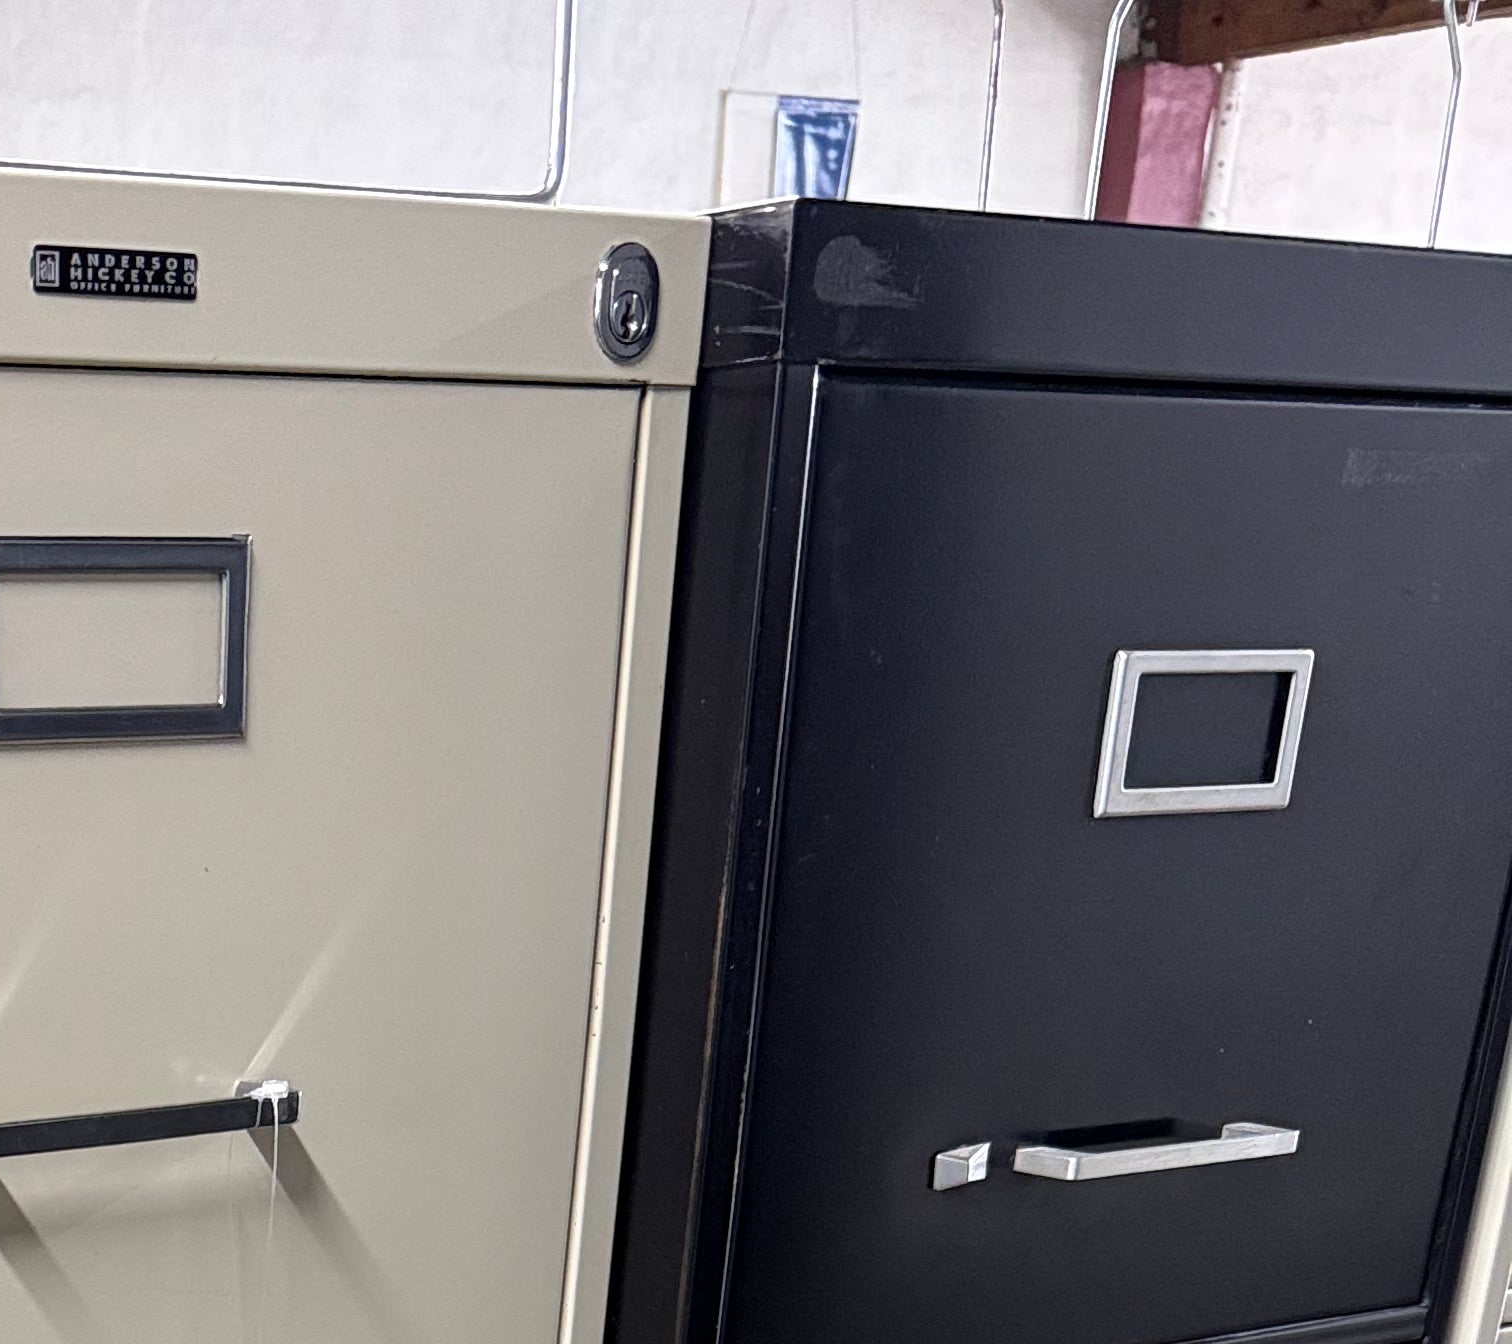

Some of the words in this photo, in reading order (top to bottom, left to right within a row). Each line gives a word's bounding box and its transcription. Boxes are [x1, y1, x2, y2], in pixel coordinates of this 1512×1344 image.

[70, 252, 195, 272] ANDERSON
[70, 267, 155, 283] HICKEY
[70, 281, 117, 293] OFFICE
